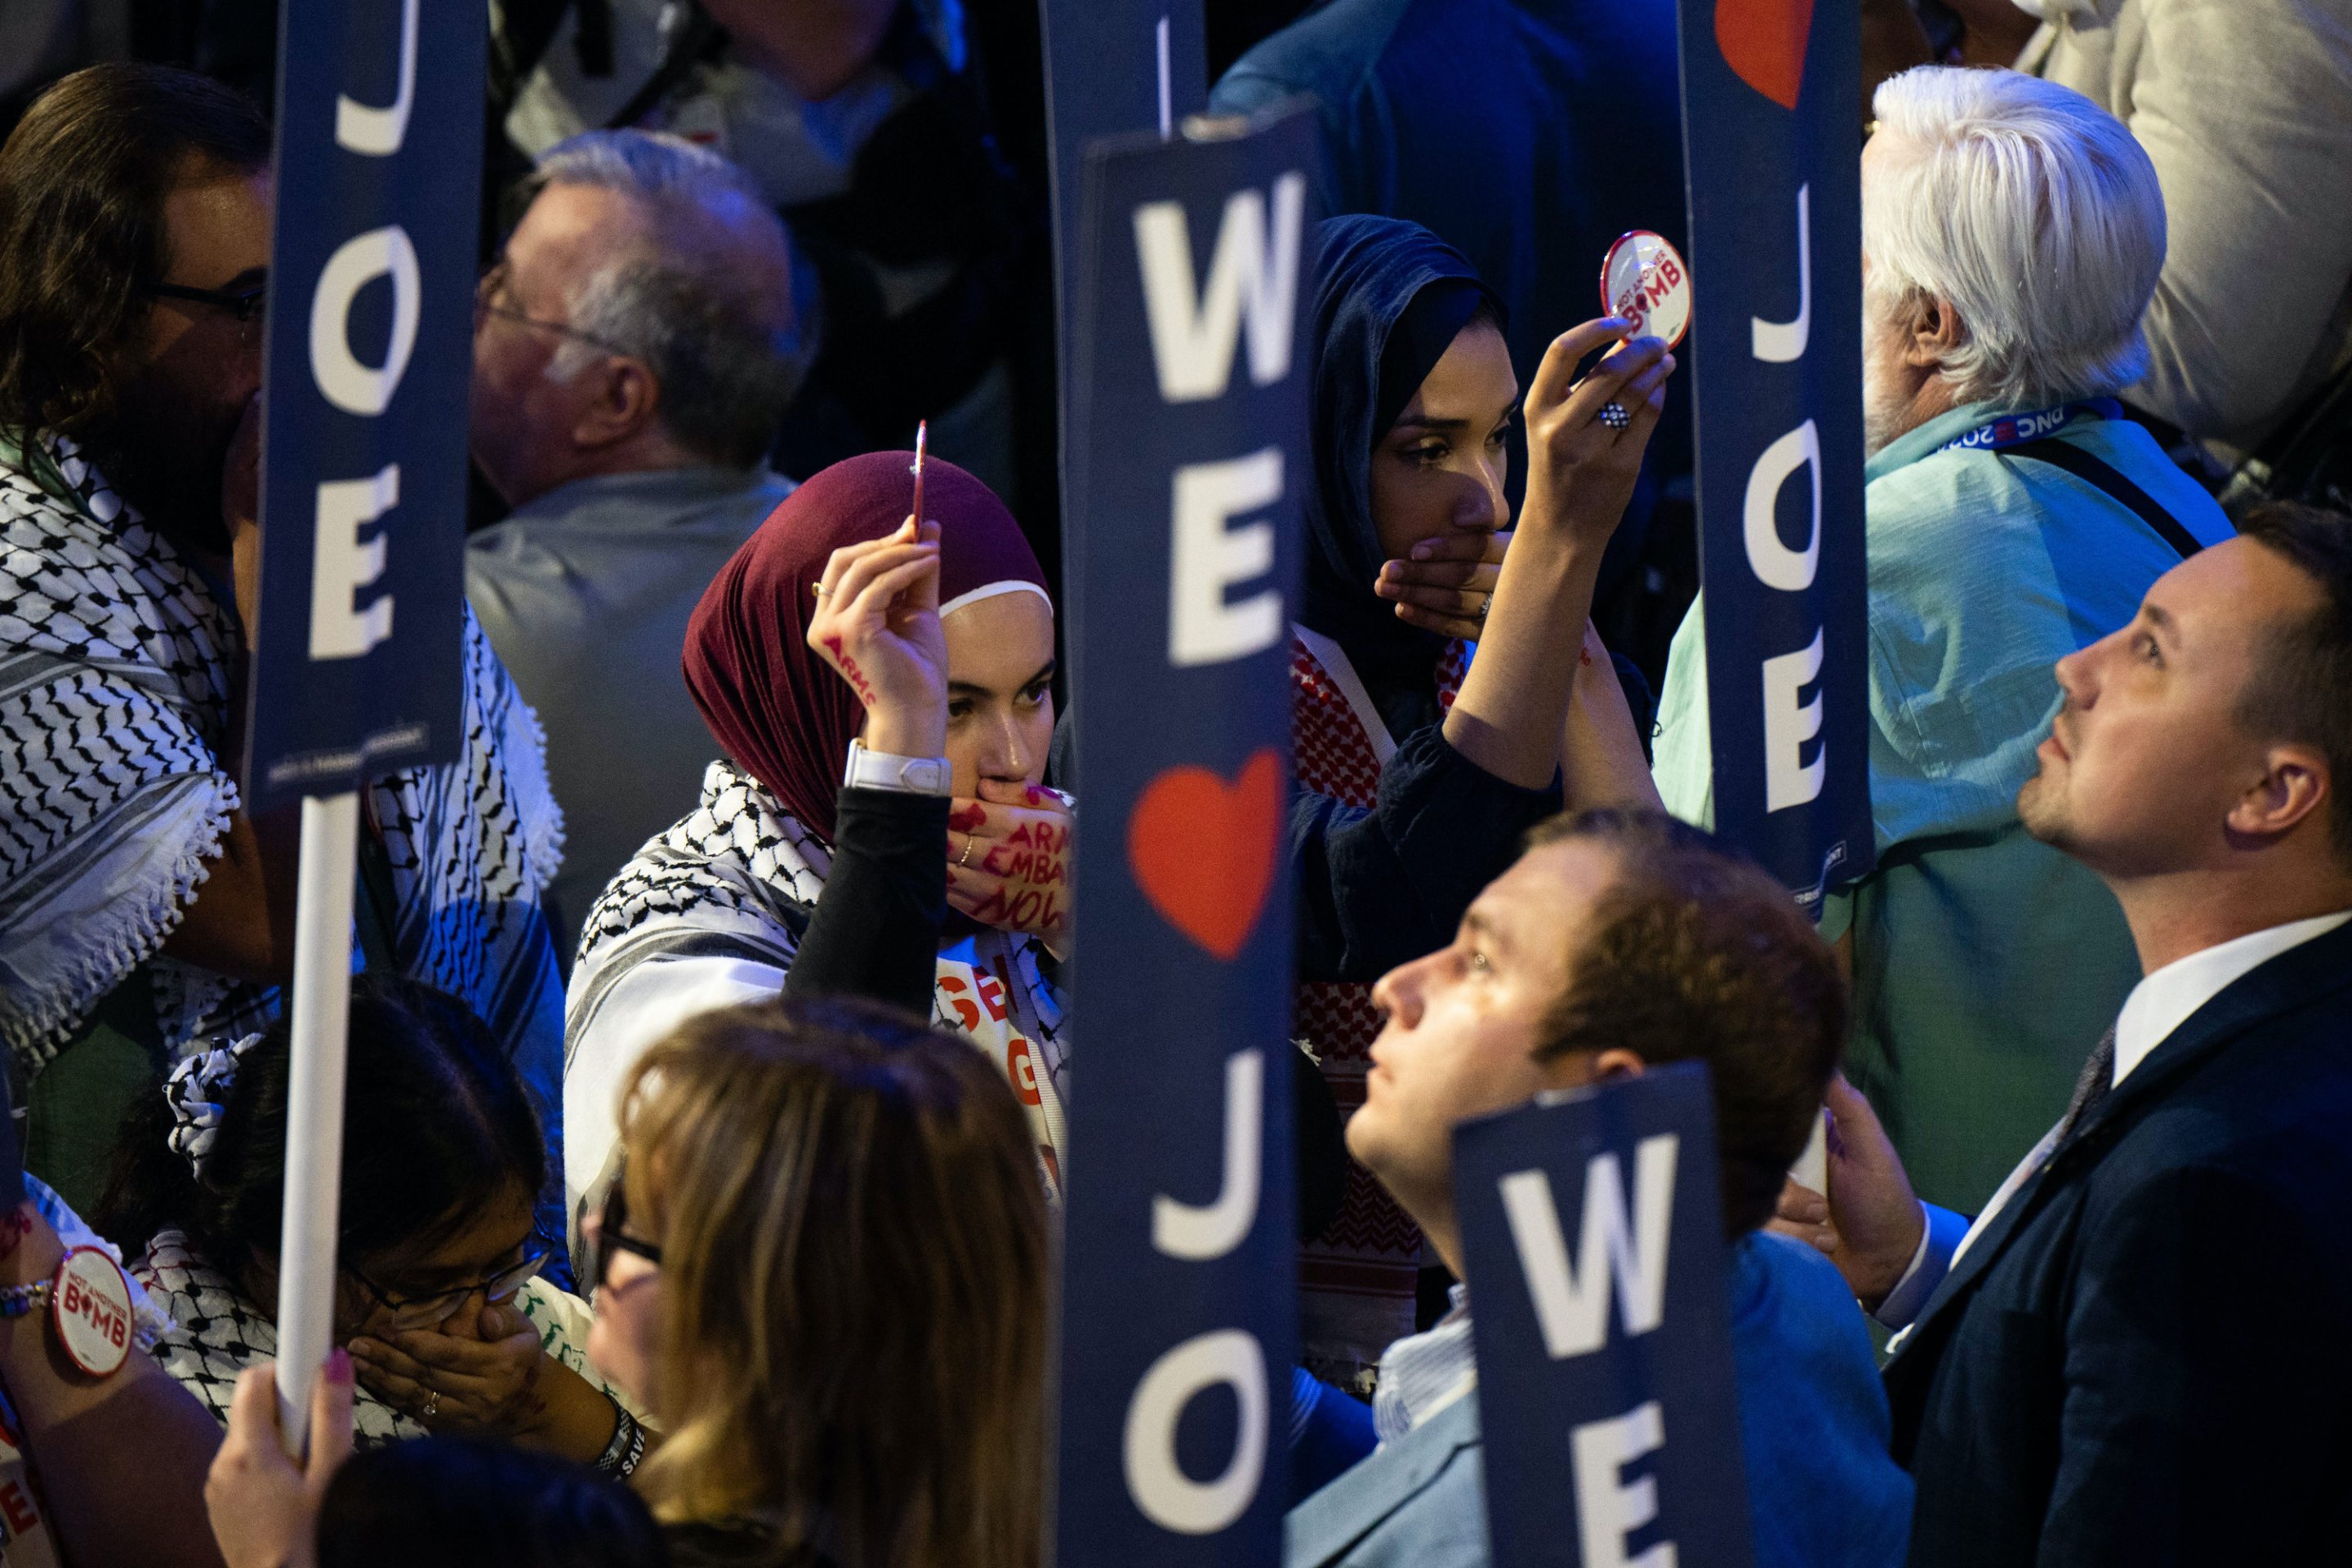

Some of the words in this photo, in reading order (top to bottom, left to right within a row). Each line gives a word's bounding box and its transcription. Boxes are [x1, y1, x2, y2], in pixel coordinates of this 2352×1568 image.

[309, 0, 421, 661] JOE
[1132, 171, 1306, 668] WE
[1743, 180, 1827, 815] JOE
[1937, 424, 1994, 452] 20
[2016, 407, 2065, 438] DNC
[621, 1427, 645, 1475] SAVE
[1497, 1133, 1680, 1568] WE
